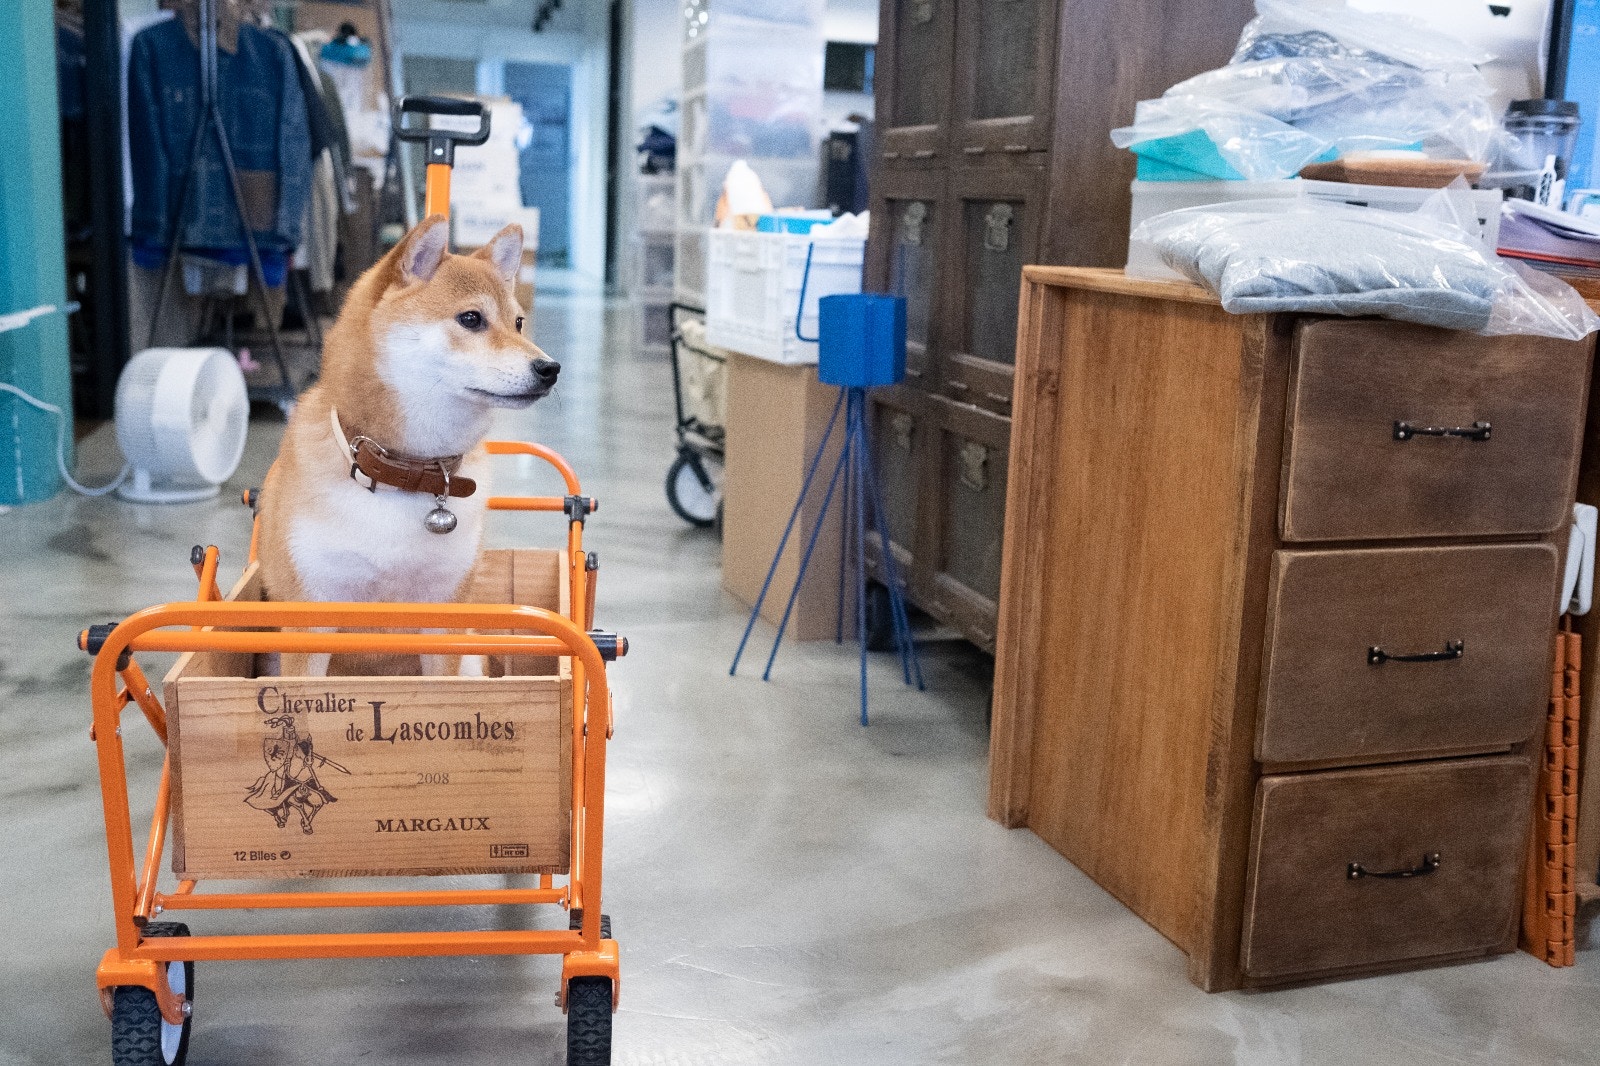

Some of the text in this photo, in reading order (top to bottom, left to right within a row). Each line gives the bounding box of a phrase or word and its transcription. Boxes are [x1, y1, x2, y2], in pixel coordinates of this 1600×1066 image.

[257, 686, 356, 714] Chevalier
[346, 701, 515, 745] de Lascombes
[416, 773, 449, 785] 2008
[375, 817, 491, 833] MARGAUX
[233, 851, 247, 861] 12
